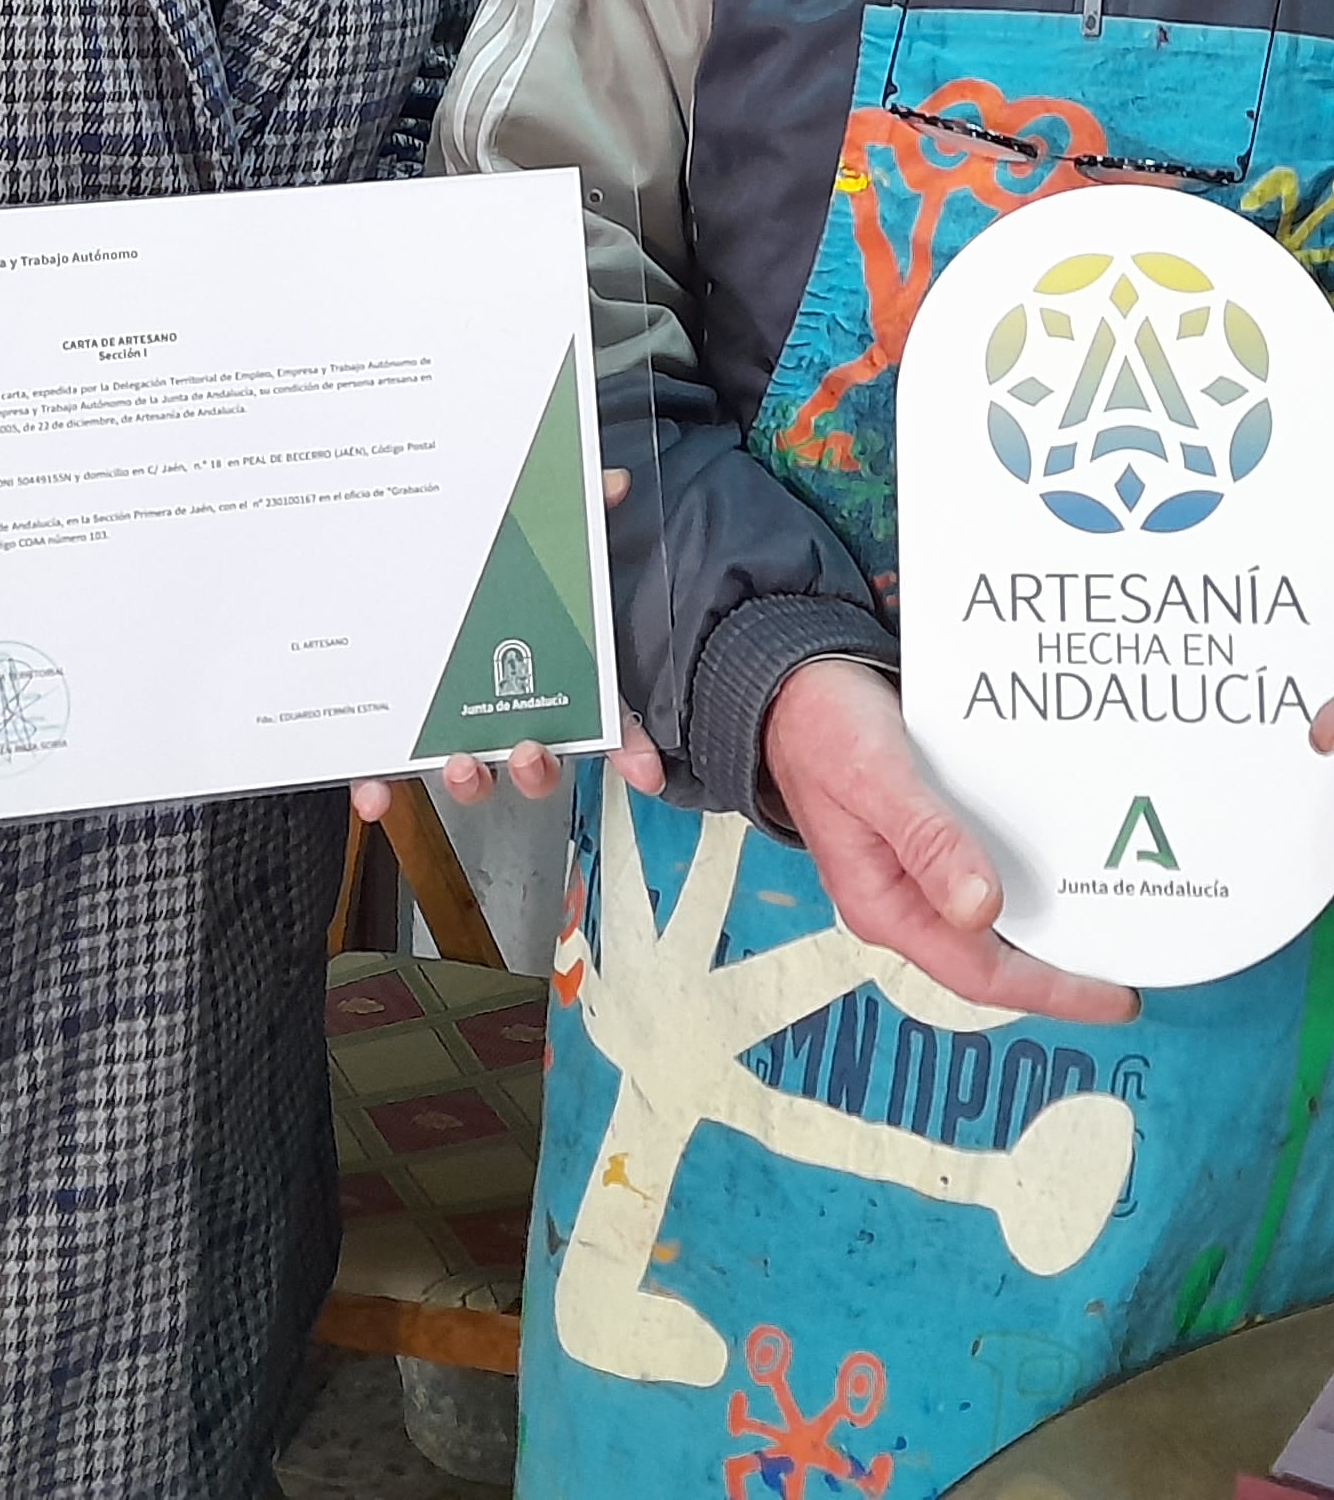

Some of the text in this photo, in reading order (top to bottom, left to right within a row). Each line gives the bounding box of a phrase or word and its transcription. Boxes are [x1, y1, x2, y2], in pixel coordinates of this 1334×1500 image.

[8, 258, 18, 271] y
[19, 252, 70, 268] Trabajo
[70, 248, 139, 264] Autónomo
[61, 332, 179, 352] CARTA DE ARTESANO
[98, 347, 148, 363] Sección I
[962, 566, 1311, 626] ARTESANÍA
[1037, 631, 1234, 666] HECHA EN
[460, 692, 570, 716] Junta de Andalucía
[963, 665, 1313, 725] ANDALUCÍA
[1057, 877, 1230, 899] Junta de Andalucía
